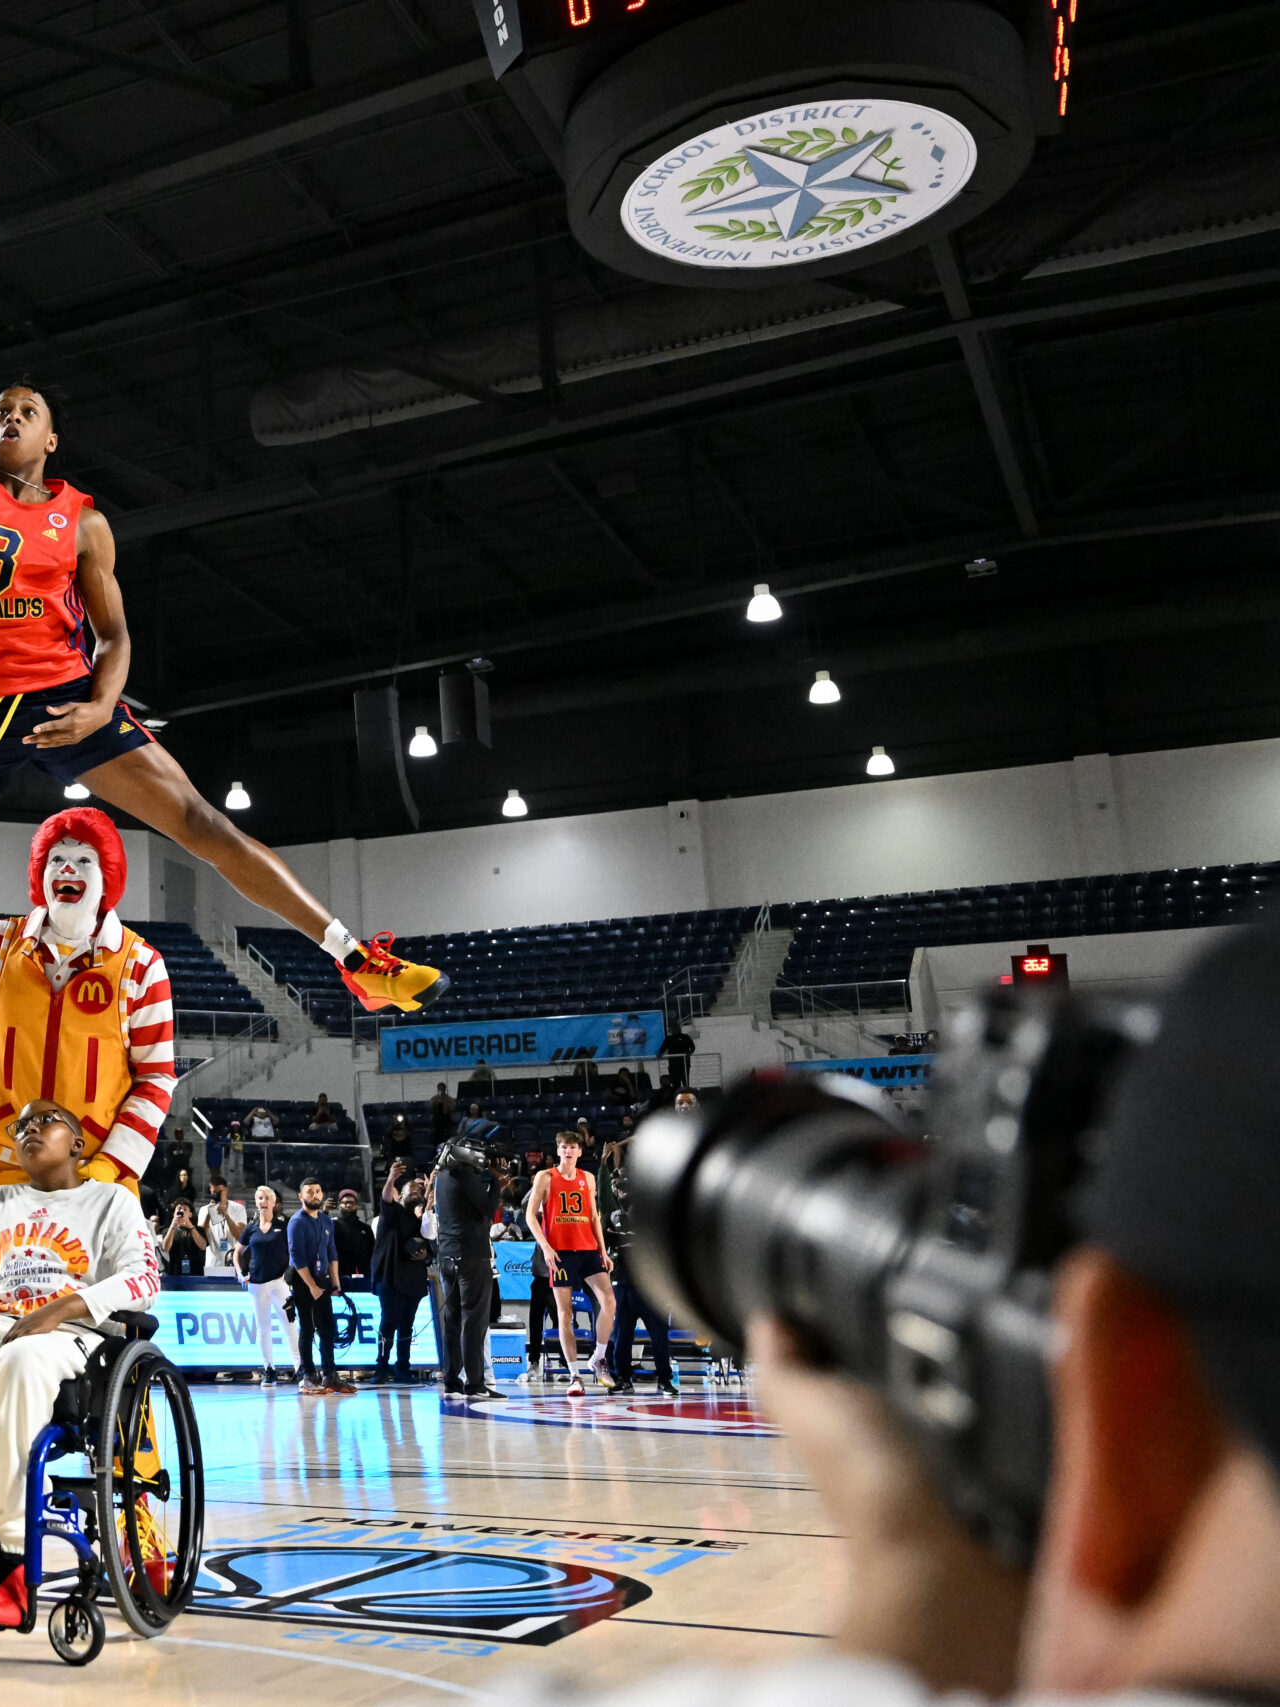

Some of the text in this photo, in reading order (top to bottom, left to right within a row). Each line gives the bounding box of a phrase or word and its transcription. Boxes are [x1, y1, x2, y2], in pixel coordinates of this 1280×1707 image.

[633, 103, 909, 262] HOUSTON INDEPENDENT SCHOOL DISTRICT
[1023, 958, 1049, 972] 26.2
[396, 1031, 537, 1060] POWERADE
[558, 1191, 584, 1215] 13
[175, 1312, 378, 1346] POWEDE
[491, 1356, 520, 1365] OWERADE
[299, 1515, 747, 1551] POWERADE
[204, 1523, 733, 1576] JAMFEST
[282, 1627, 502, 1658] 2023
